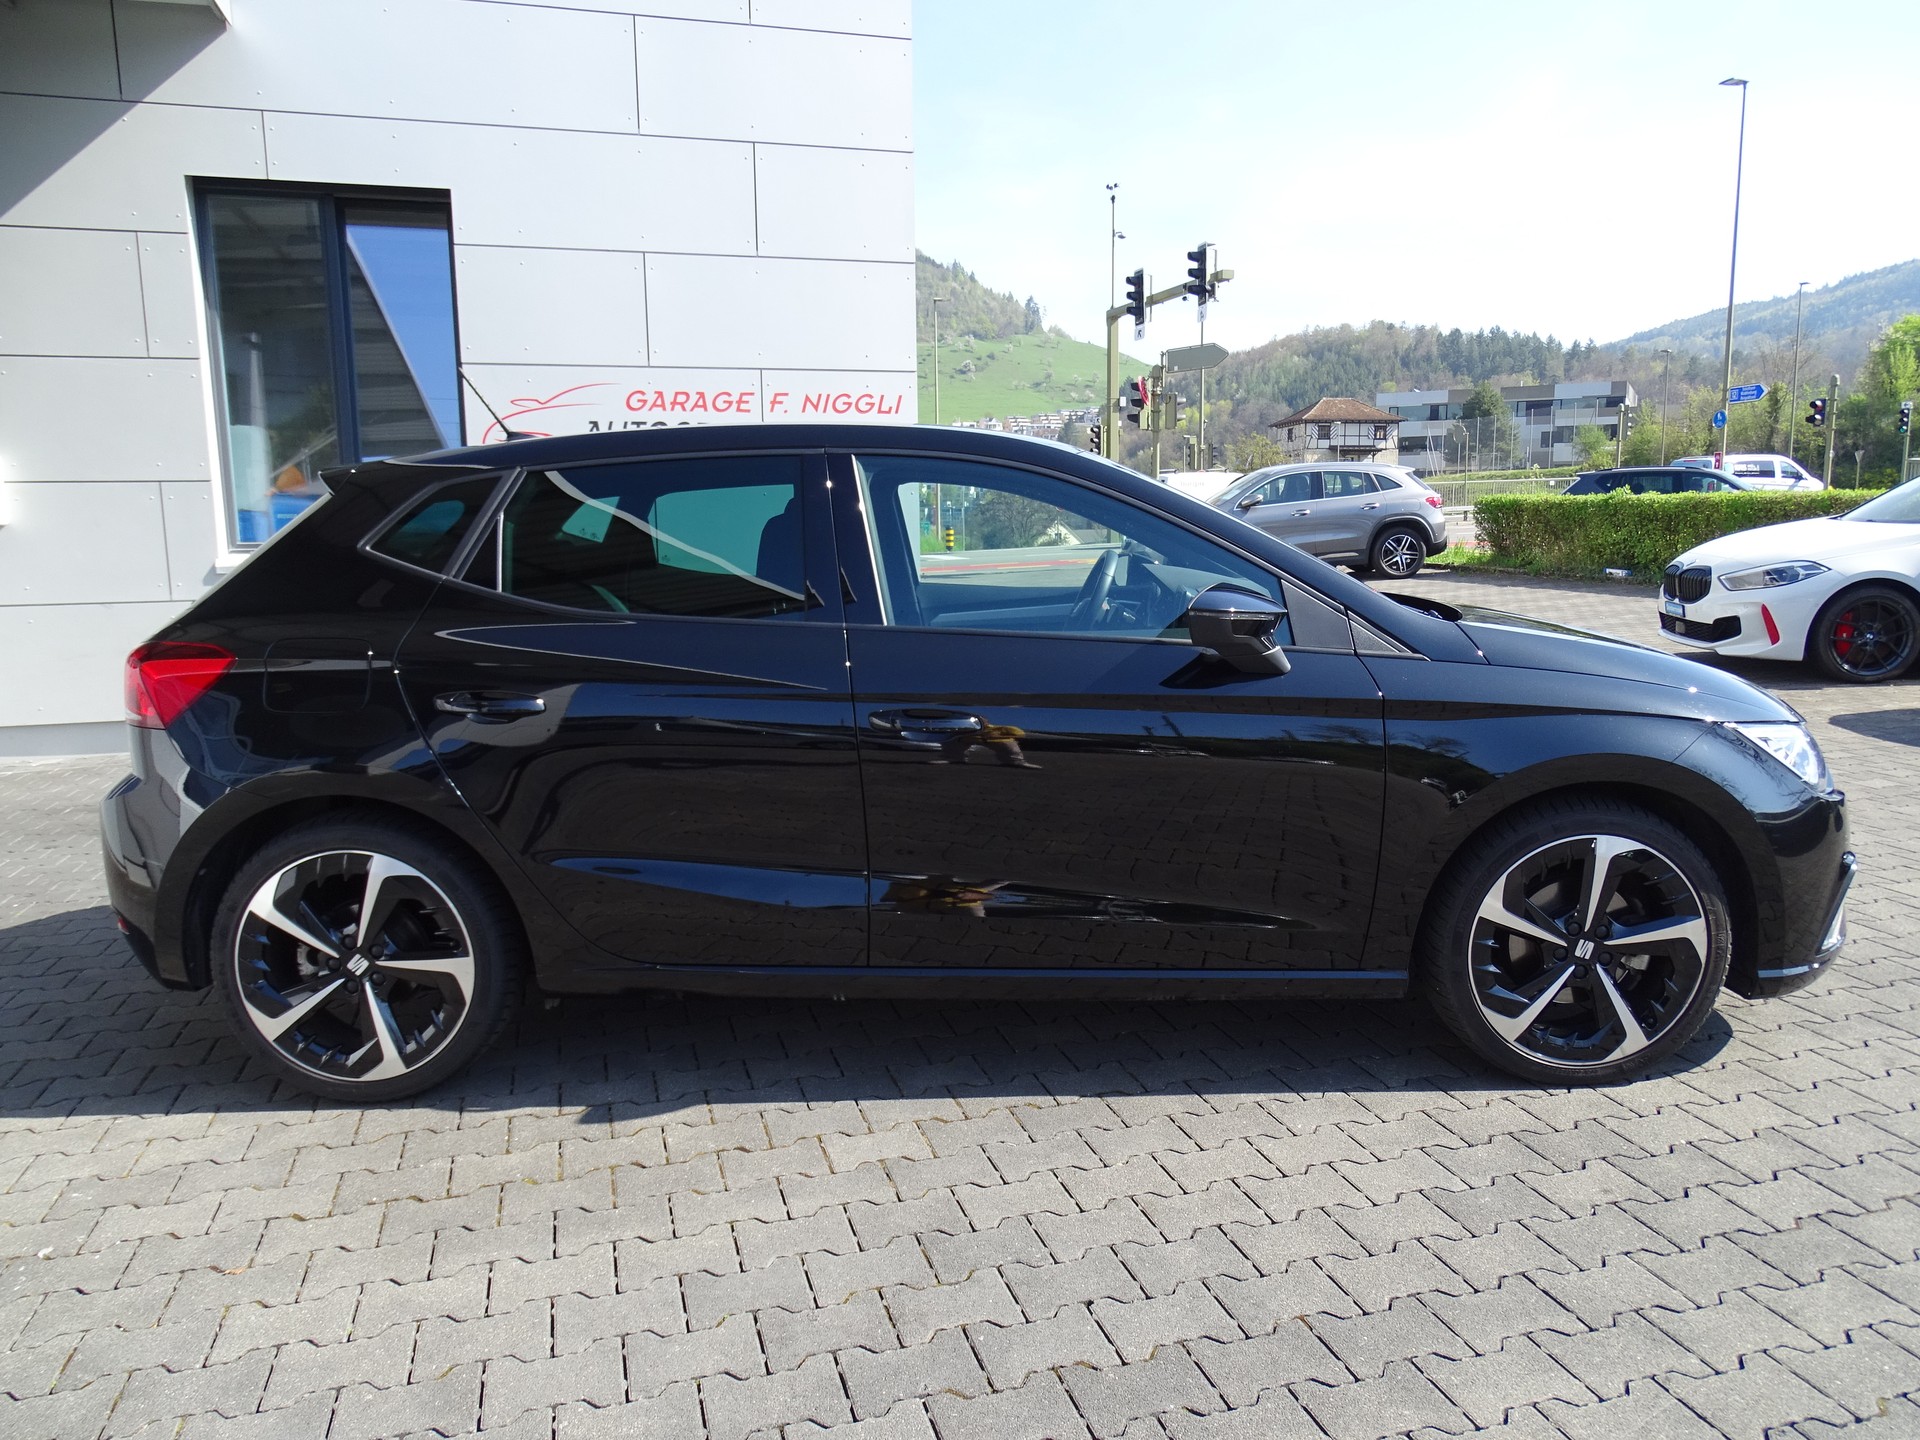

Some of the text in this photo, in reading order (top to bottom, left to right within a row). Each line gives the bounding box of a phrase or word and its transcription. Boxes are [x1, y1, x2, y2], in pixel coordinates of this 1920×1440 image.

[625, 390, 902, 414] GARAGE F. NIGGLI
